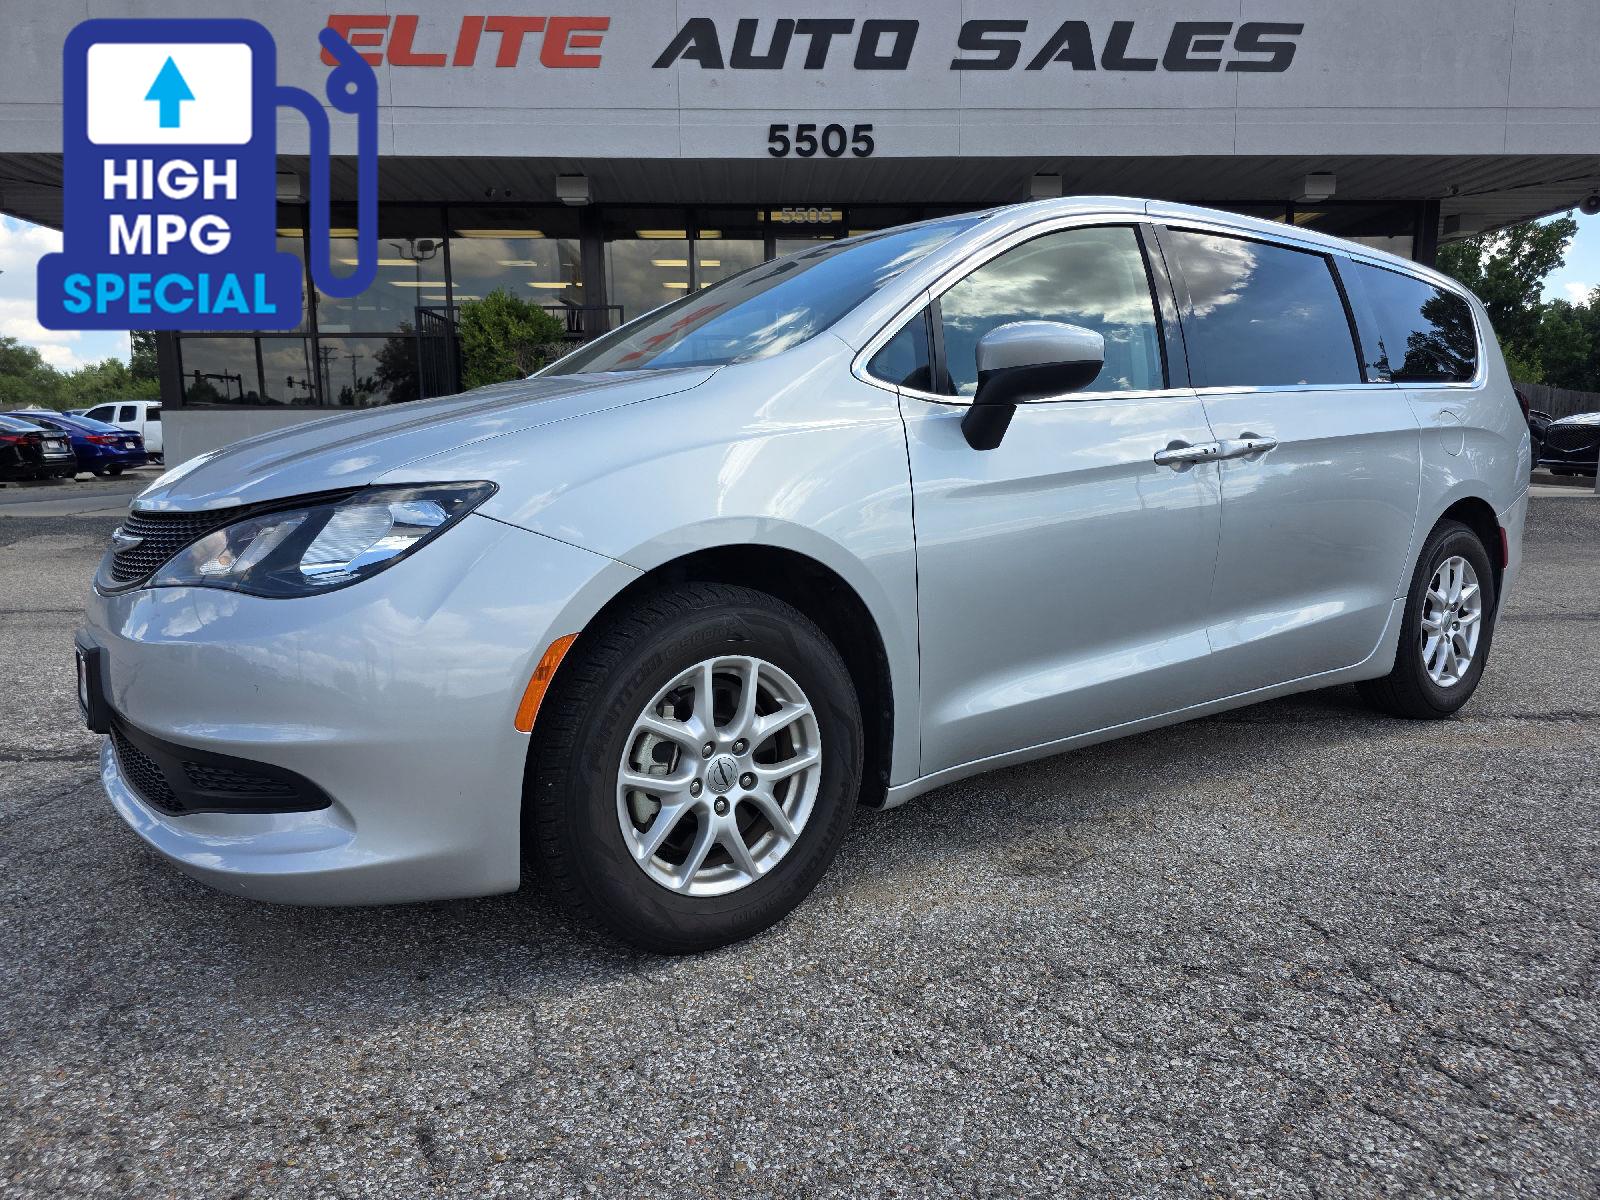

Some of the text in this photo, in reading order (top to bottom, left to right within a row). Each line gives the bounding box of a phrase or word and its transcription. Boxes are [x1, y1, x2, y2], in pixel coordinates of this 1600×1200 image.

[320, 15, 1304, 73] ELITE AUTO SALES
[768, 124, 875, 158] 5505
[780, 207, 833, 224] 5505
